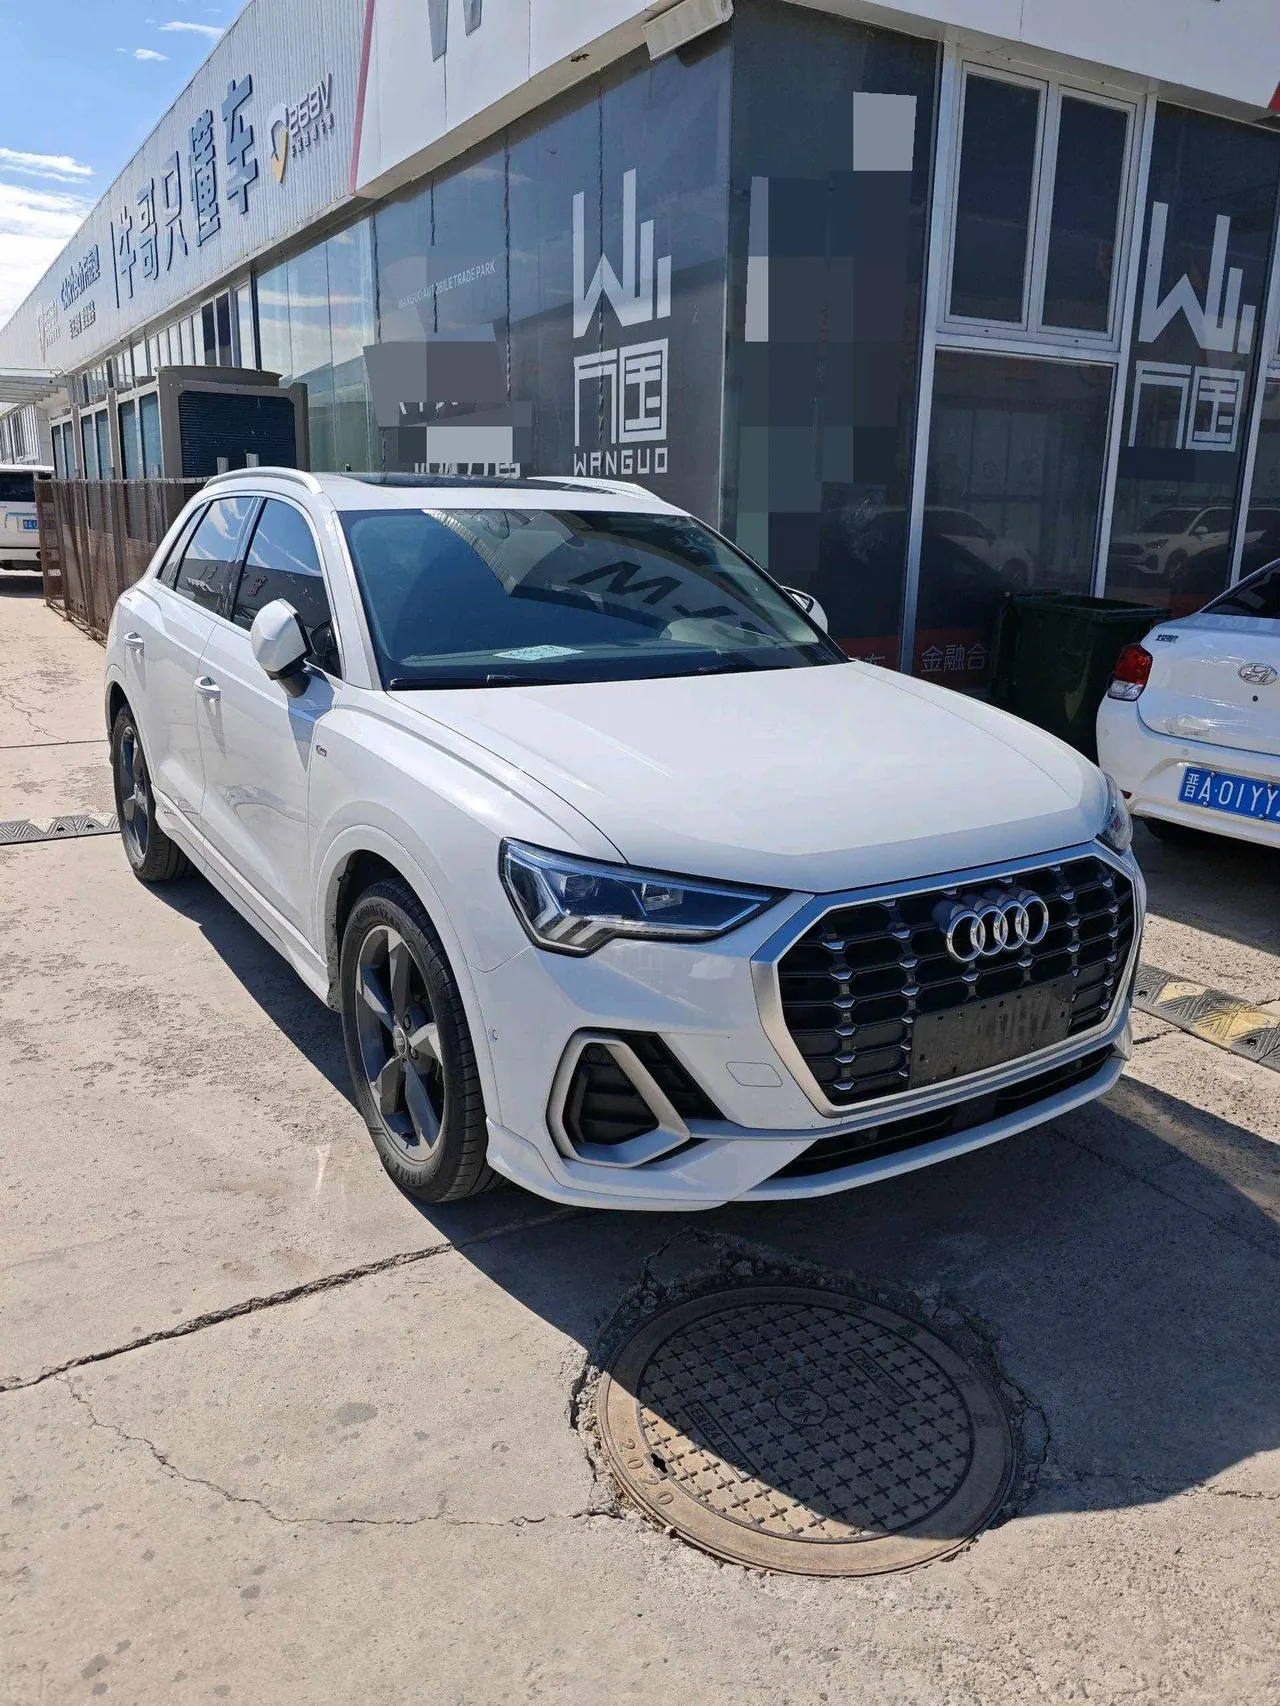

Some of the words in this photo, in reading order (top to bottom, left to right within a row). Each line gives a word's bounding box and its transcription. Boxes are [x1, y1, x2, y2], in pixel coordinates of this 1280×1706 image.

[453, 266, 475, 286] TRADE
[475, 260, 496, 279] PARK
[573, 447, 668, 477] WANGUO
[619, 1437, 676, 1506] 2020
